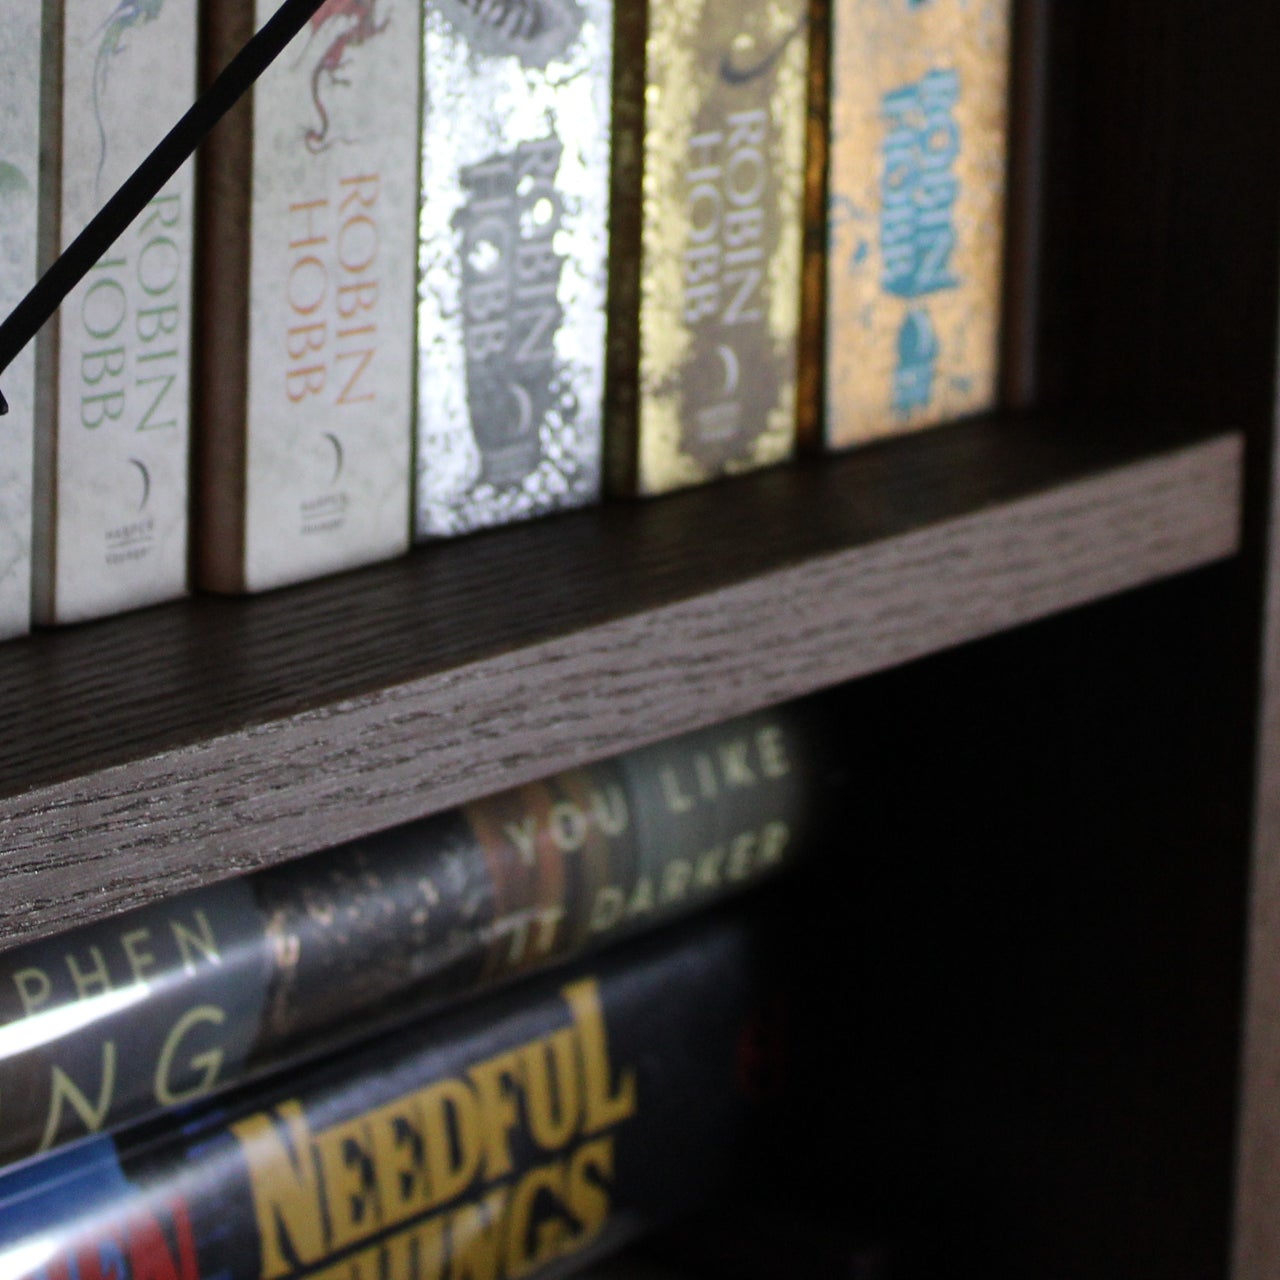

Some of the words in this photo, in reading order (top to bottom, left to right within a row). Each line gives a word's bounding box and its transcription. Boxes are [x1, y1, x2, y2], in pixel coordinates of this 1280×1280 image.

[466, 154, 515, 363] HOBB
[515, 138, 563, 365] ROBIN
[683, 131, 721, 325] HOBB
[722, 109, 768, 325] ROBIN
[881, 83, 920, 283] HOBB
[921, 69, 960, 287] ROBIN
[135, 193, 181, 433] ROBIN
[286, 199, 328, 404] HOBB
[334, 173, 380, 406] ROBIN
[505, 783, 630, 868] YOU
[660, 724, 792, 814] LIKE
[590, 819, 792, 934] DARKER
[228, 977, 640, 1278] NEEDFUL
